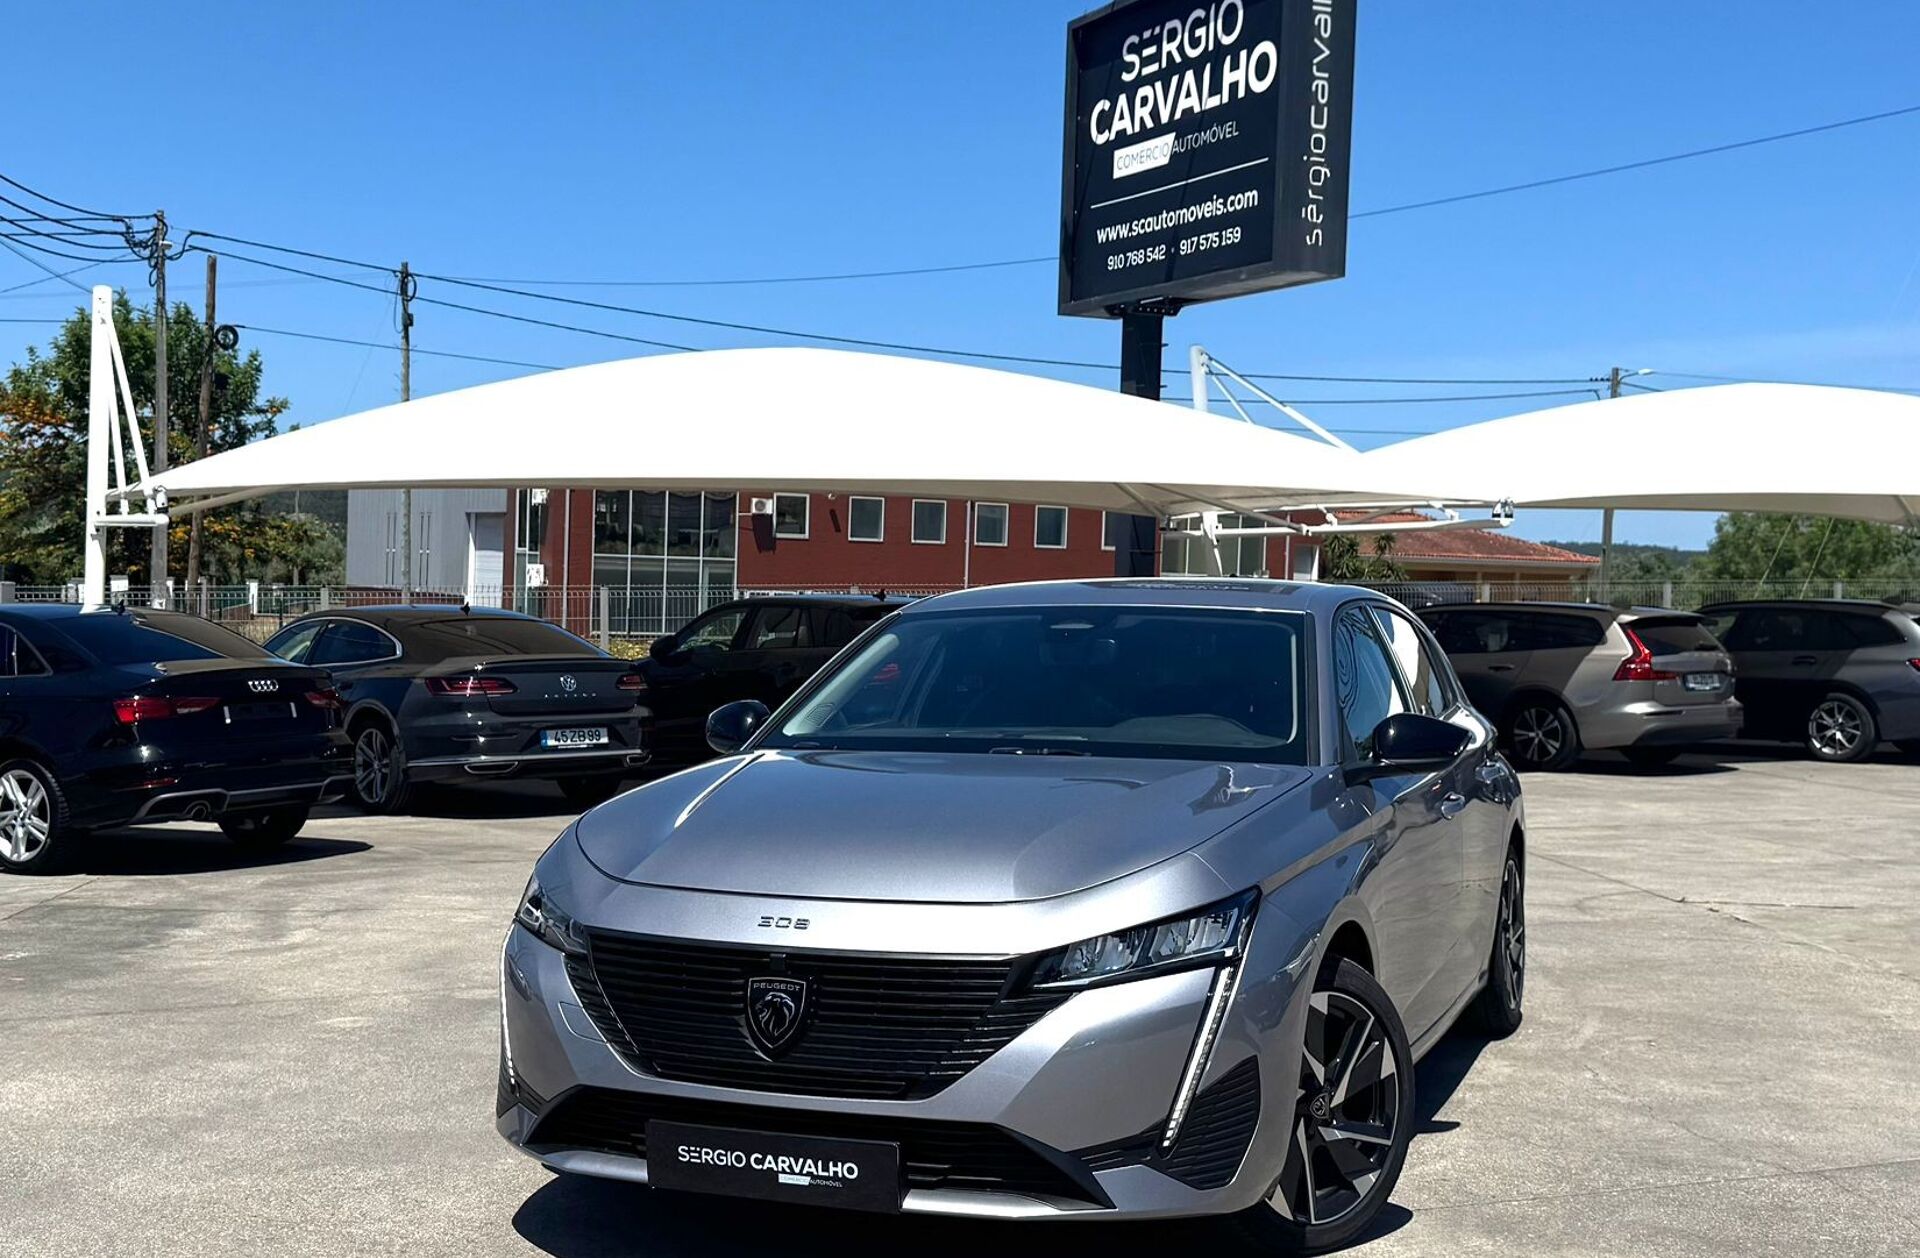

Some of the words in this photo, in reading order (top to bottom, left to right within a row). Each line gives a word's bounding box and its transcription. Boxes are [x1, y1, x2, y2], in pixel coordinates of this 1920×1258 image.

[1090, 40, 1278, 145] CARVALHO
[1171, 121, 1240, 155] AUTOMÓVEL
[1096, 189, 1258, 244] www.scautomoveis.com
[1107, 255, 1125, 271] 910
[1126, 249, 1145, 267] 768
[1146, 244, 1166, 263] 542
[1179, 236, 1198, 255] 917
[1199, 231, 1219, 251] 575
[1221, 226, 1241, 246] 159
[757, 916, 810, 930] 308
[753, 982, 800, 991] PEUGEOT
[750, 1152, 859, 1180] CARVALHO
